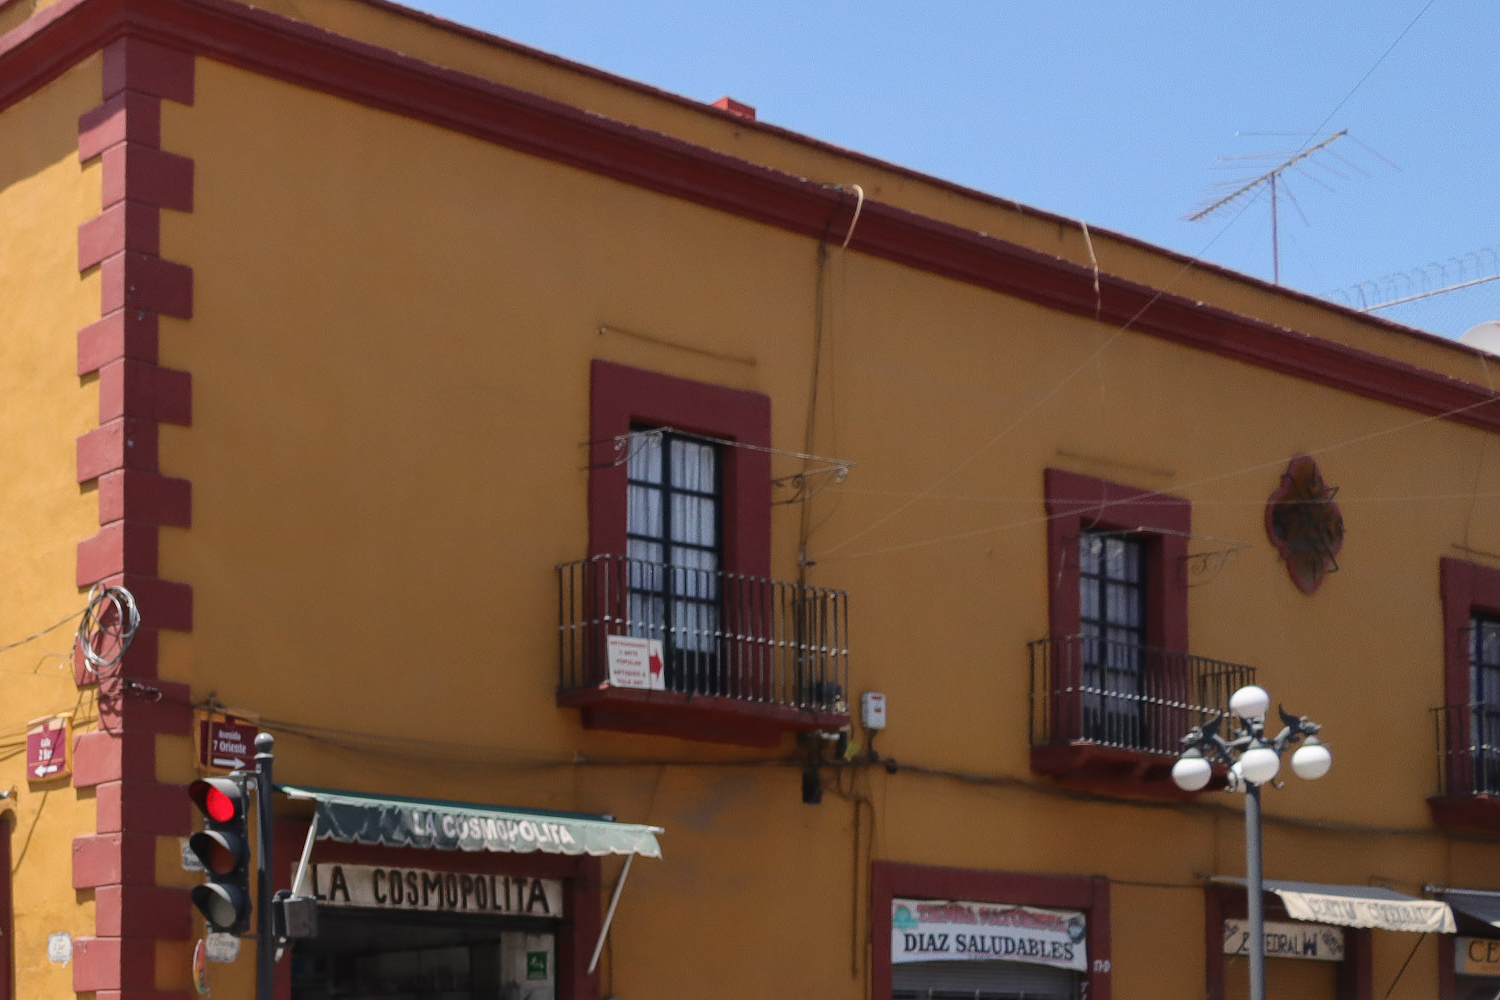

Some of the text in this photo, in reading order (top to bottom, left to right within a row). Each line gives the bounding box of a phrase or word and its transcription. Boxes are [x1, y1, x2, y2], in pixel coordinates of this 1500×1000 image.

[213, 740, 247, 755] 7 Oriente
[218, 729, 241, 741] Avenida
[412, 811, 576, 845] LA COSMOPOLITA
[311, 863, 550, 914] LA COSMOPOLITA
[904, 932, 1075, 960] DIAZ SALUDABLES
